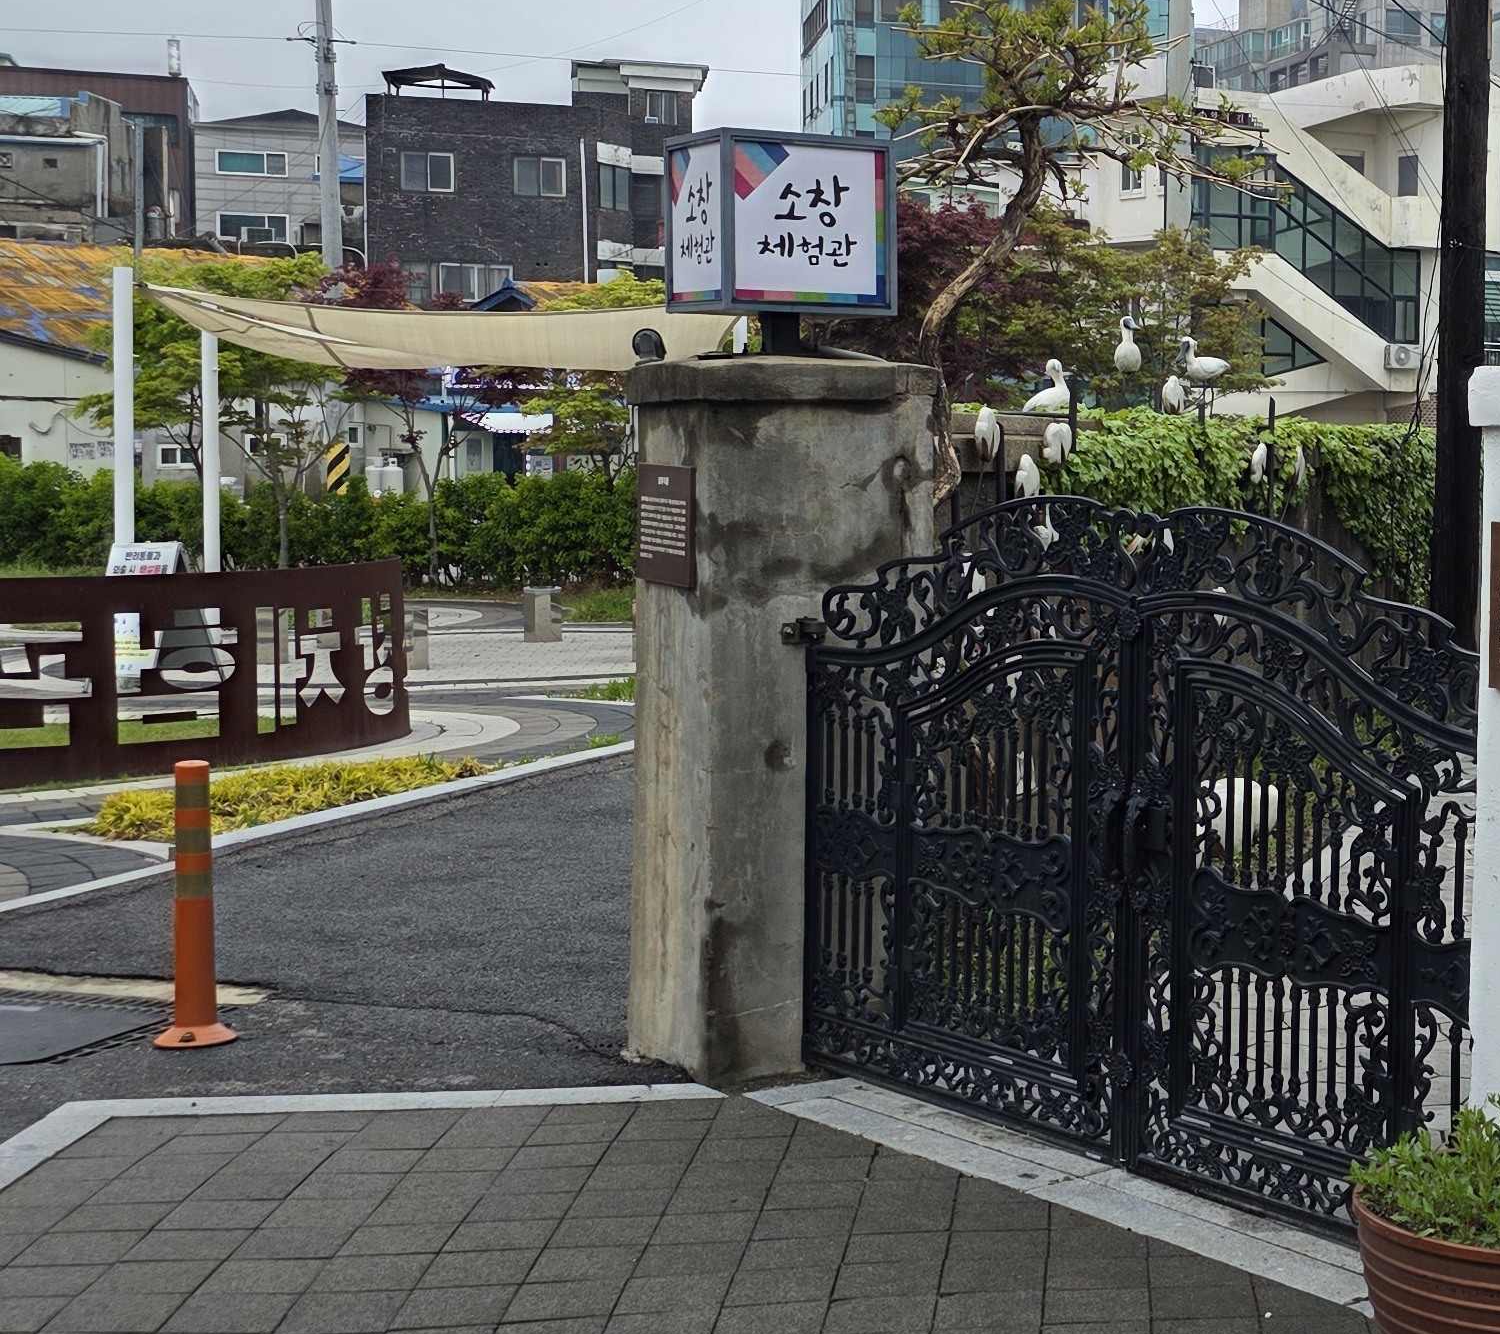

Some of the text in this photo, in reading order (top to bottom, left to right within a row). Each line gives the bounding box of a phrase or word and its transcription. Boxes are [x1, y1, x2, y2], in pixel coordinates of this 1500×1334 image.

[685, 171, 713, 226] 소창
[774, 175, 850, 228] 소창
[680, 229, 715, 265] 체험관
[757, 231, 858, 268] 체험관
